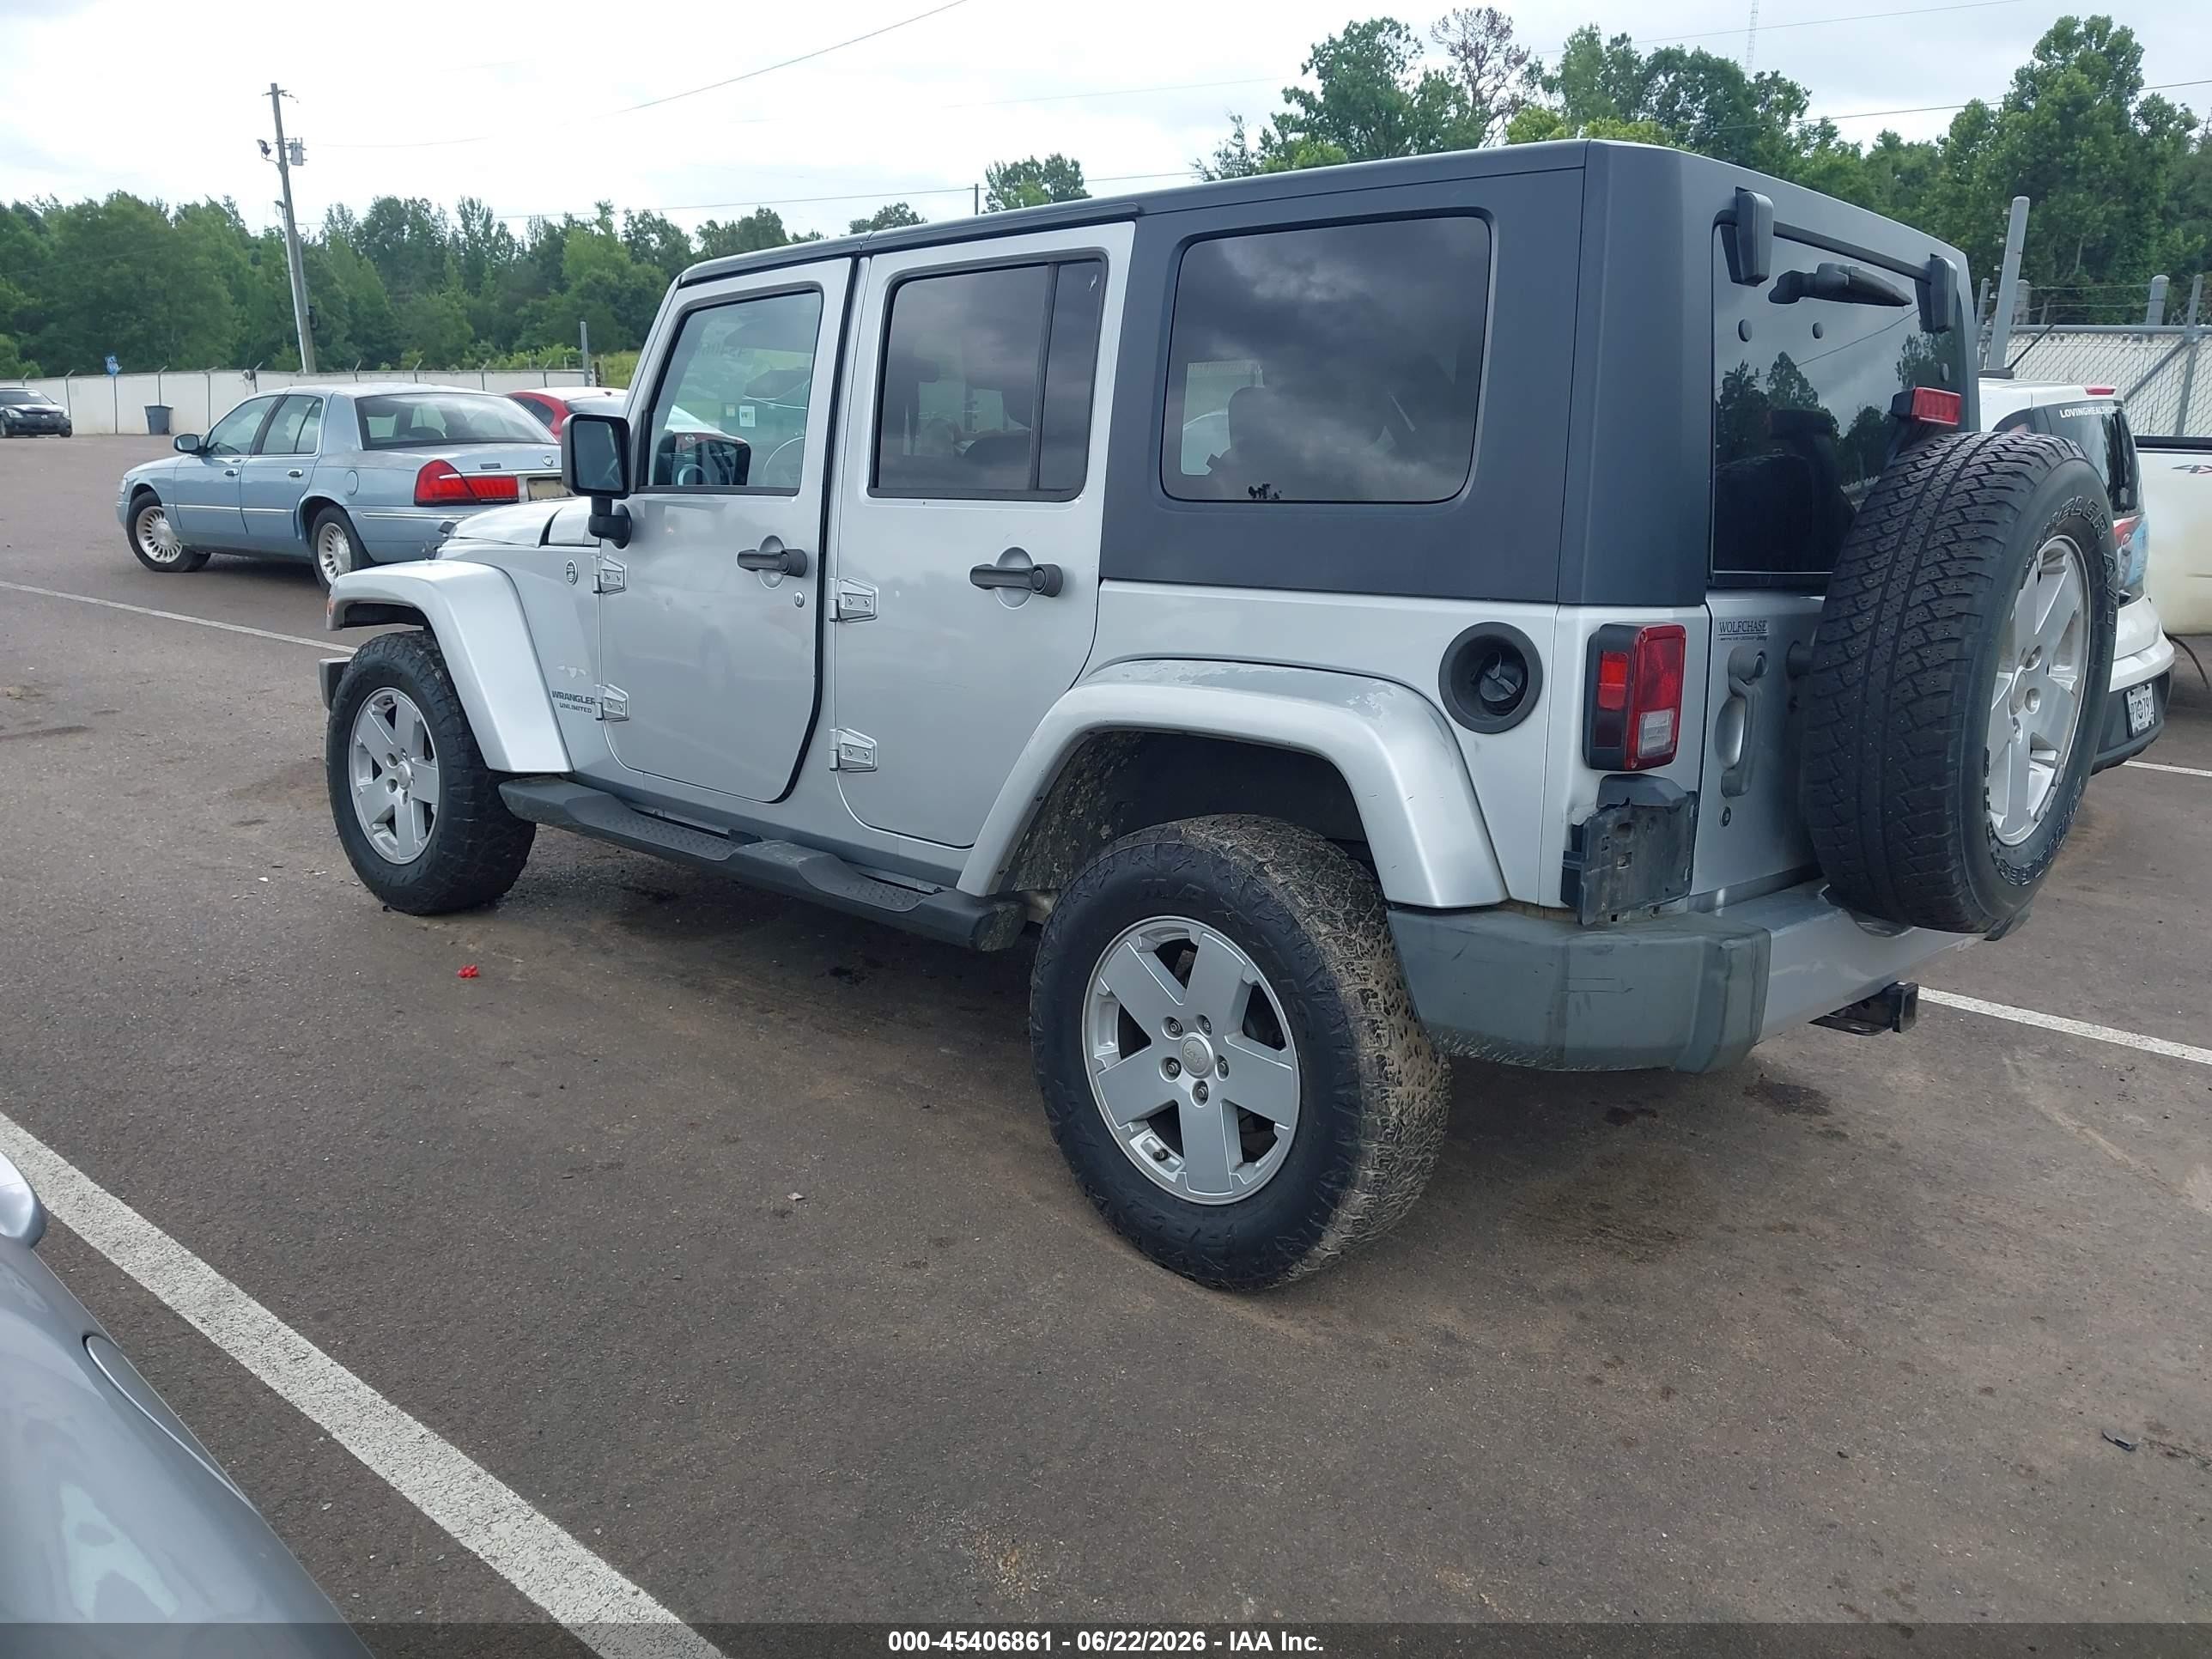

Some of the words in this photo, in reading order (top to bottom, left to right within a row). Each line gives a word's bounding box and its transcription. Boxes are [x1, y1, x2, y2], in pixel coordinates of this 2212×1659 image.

[1719, 620, 1767, 633] WOLFCHASE
[551, 690, 596, 706] WRANGLER
[559, 702, 592, 714] UNLIMITED
